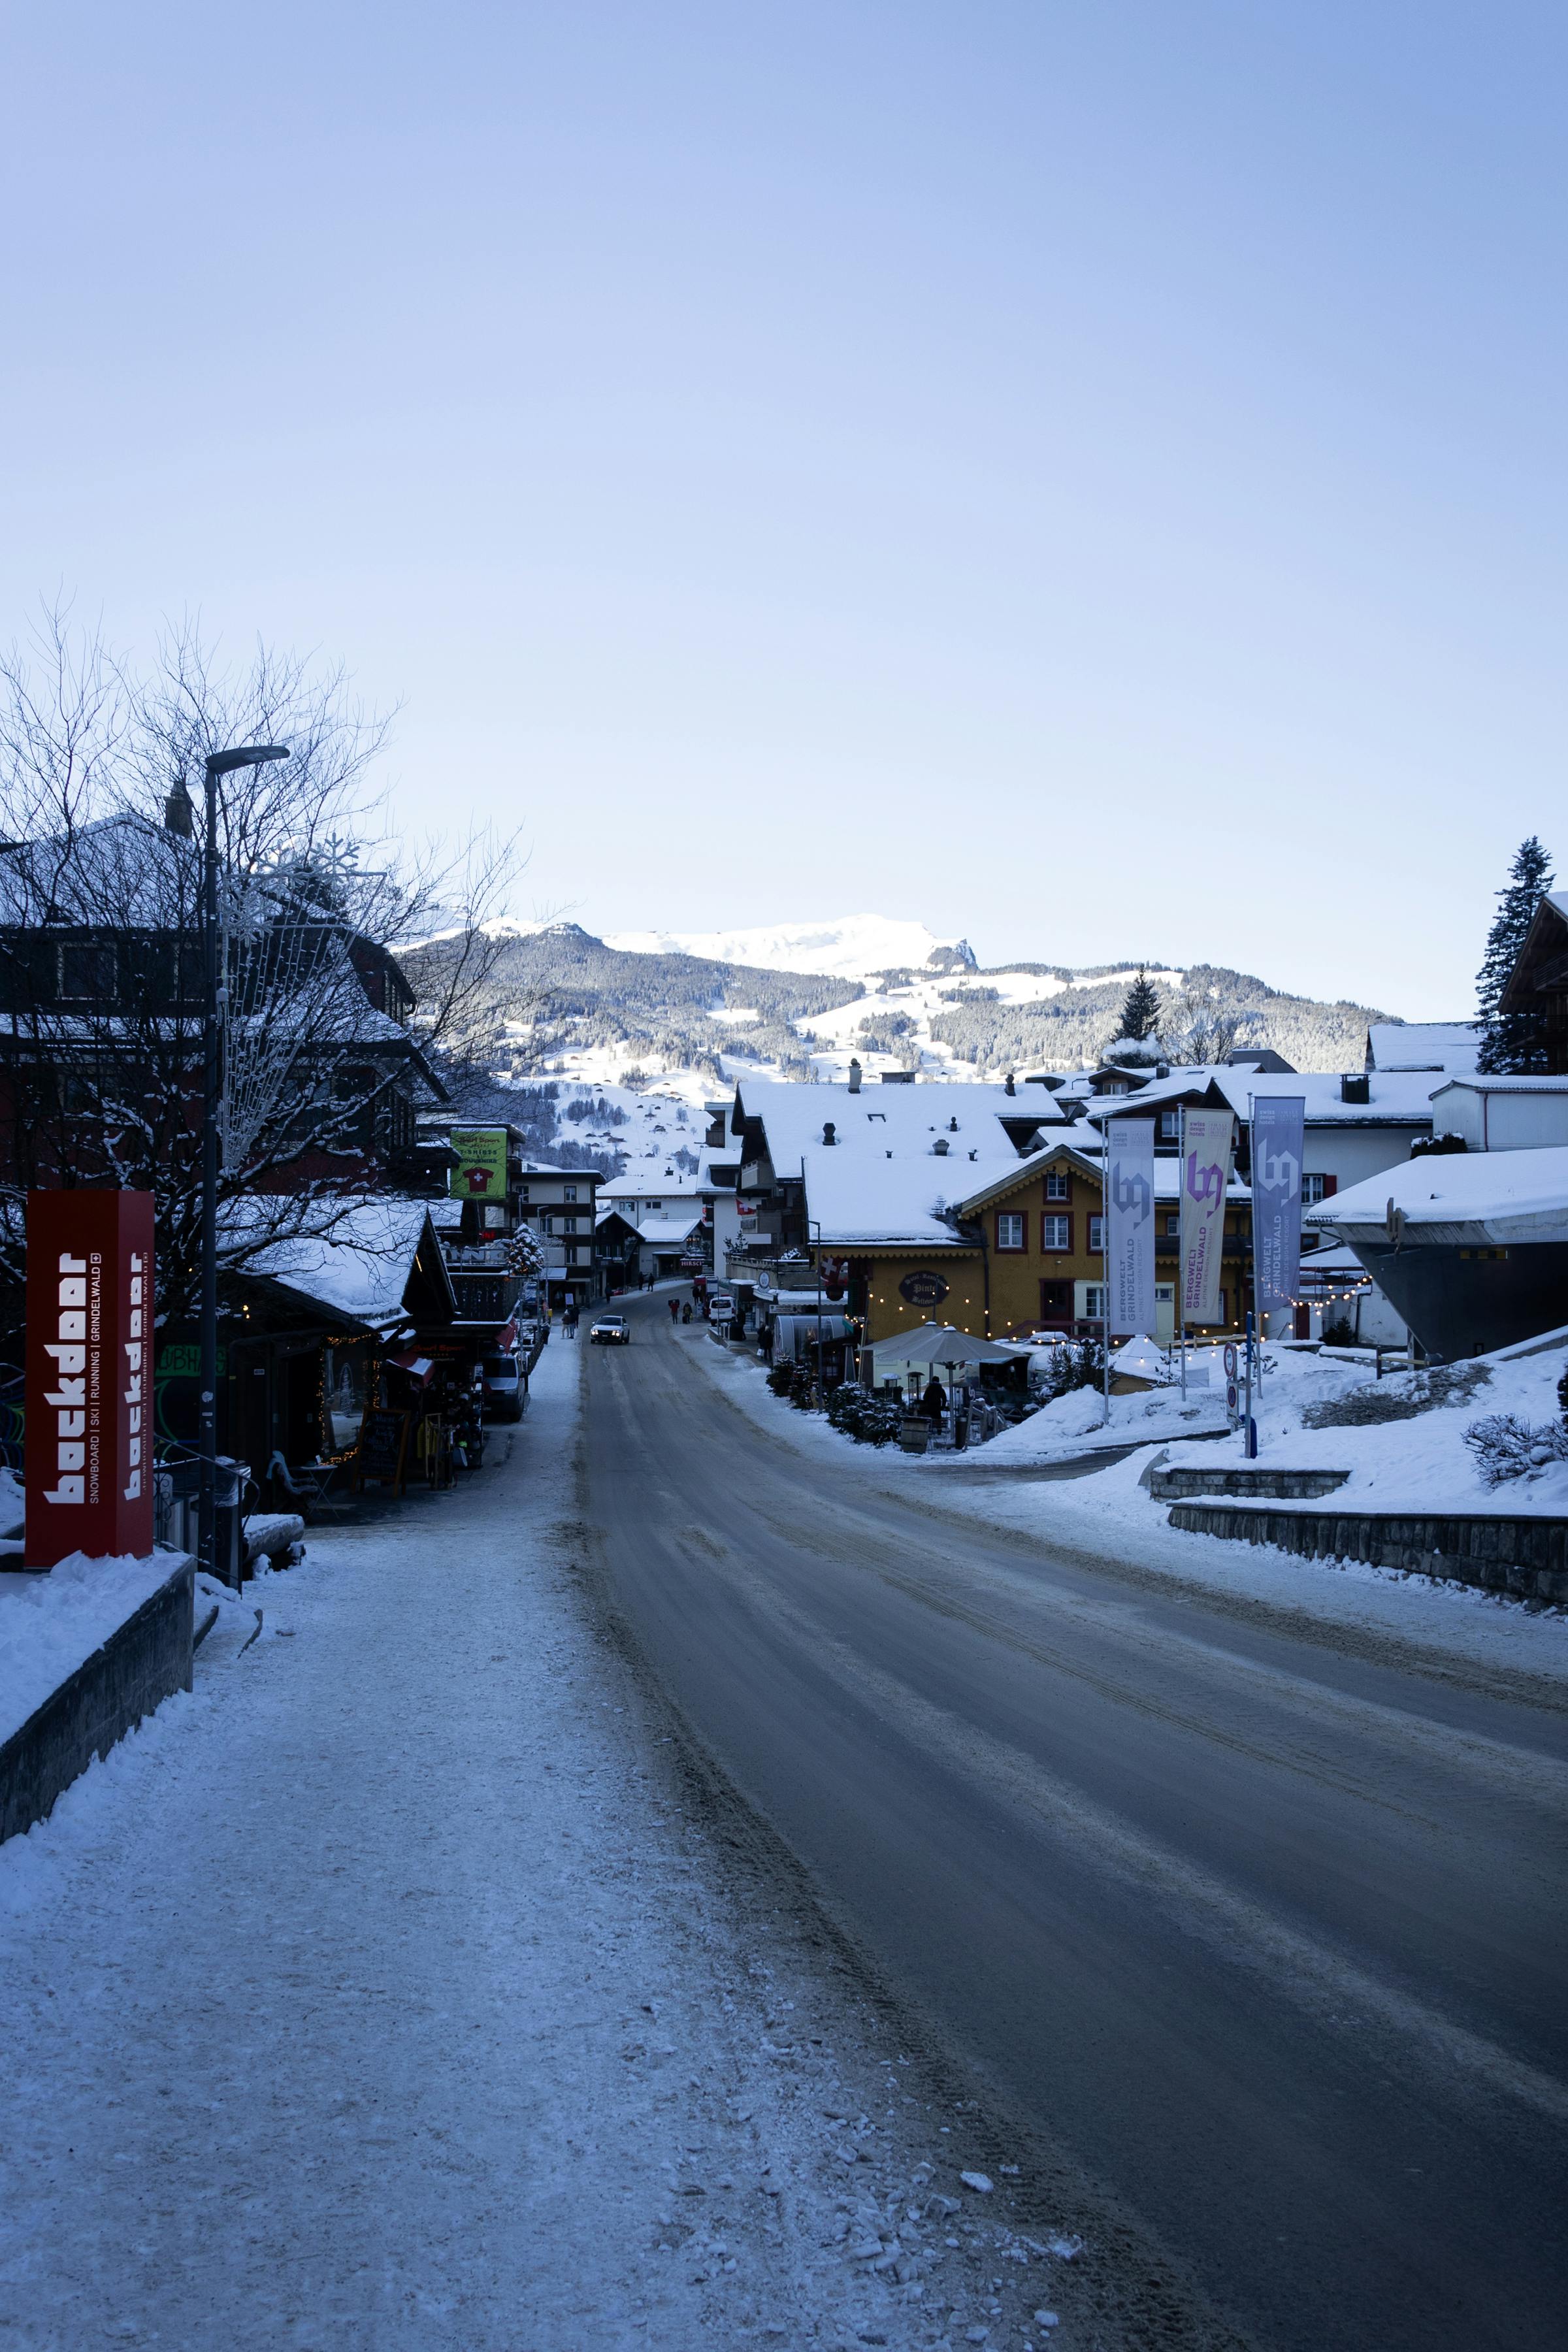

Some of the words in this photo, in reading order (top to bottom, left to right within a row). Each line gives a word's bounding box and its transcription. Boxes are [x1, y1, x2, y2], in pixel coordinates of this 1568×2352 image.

[1127, 1239, 1136, 1321] GRINDELWALD
[1186, 1249, 1196, 1308] BERGWELT
[1194, 1226, 1207, 1308] GRINDELWALD
[1263, 1236, 1271, 1298] BERGWELT
[1273, 1215, 1282, 1298] GRINDELWALD
[91, 1266, 101, 1341] GRINDELWALD
[42, 1252, 86, 1504] backdoor
[90, 1351, 100, 1398] RUNNING
[124, 1252, 142, 1501] backdoor
[90, 1409, 100, 1426] SKI
[90, 1436, 99, 1504] SNOWBOARD
